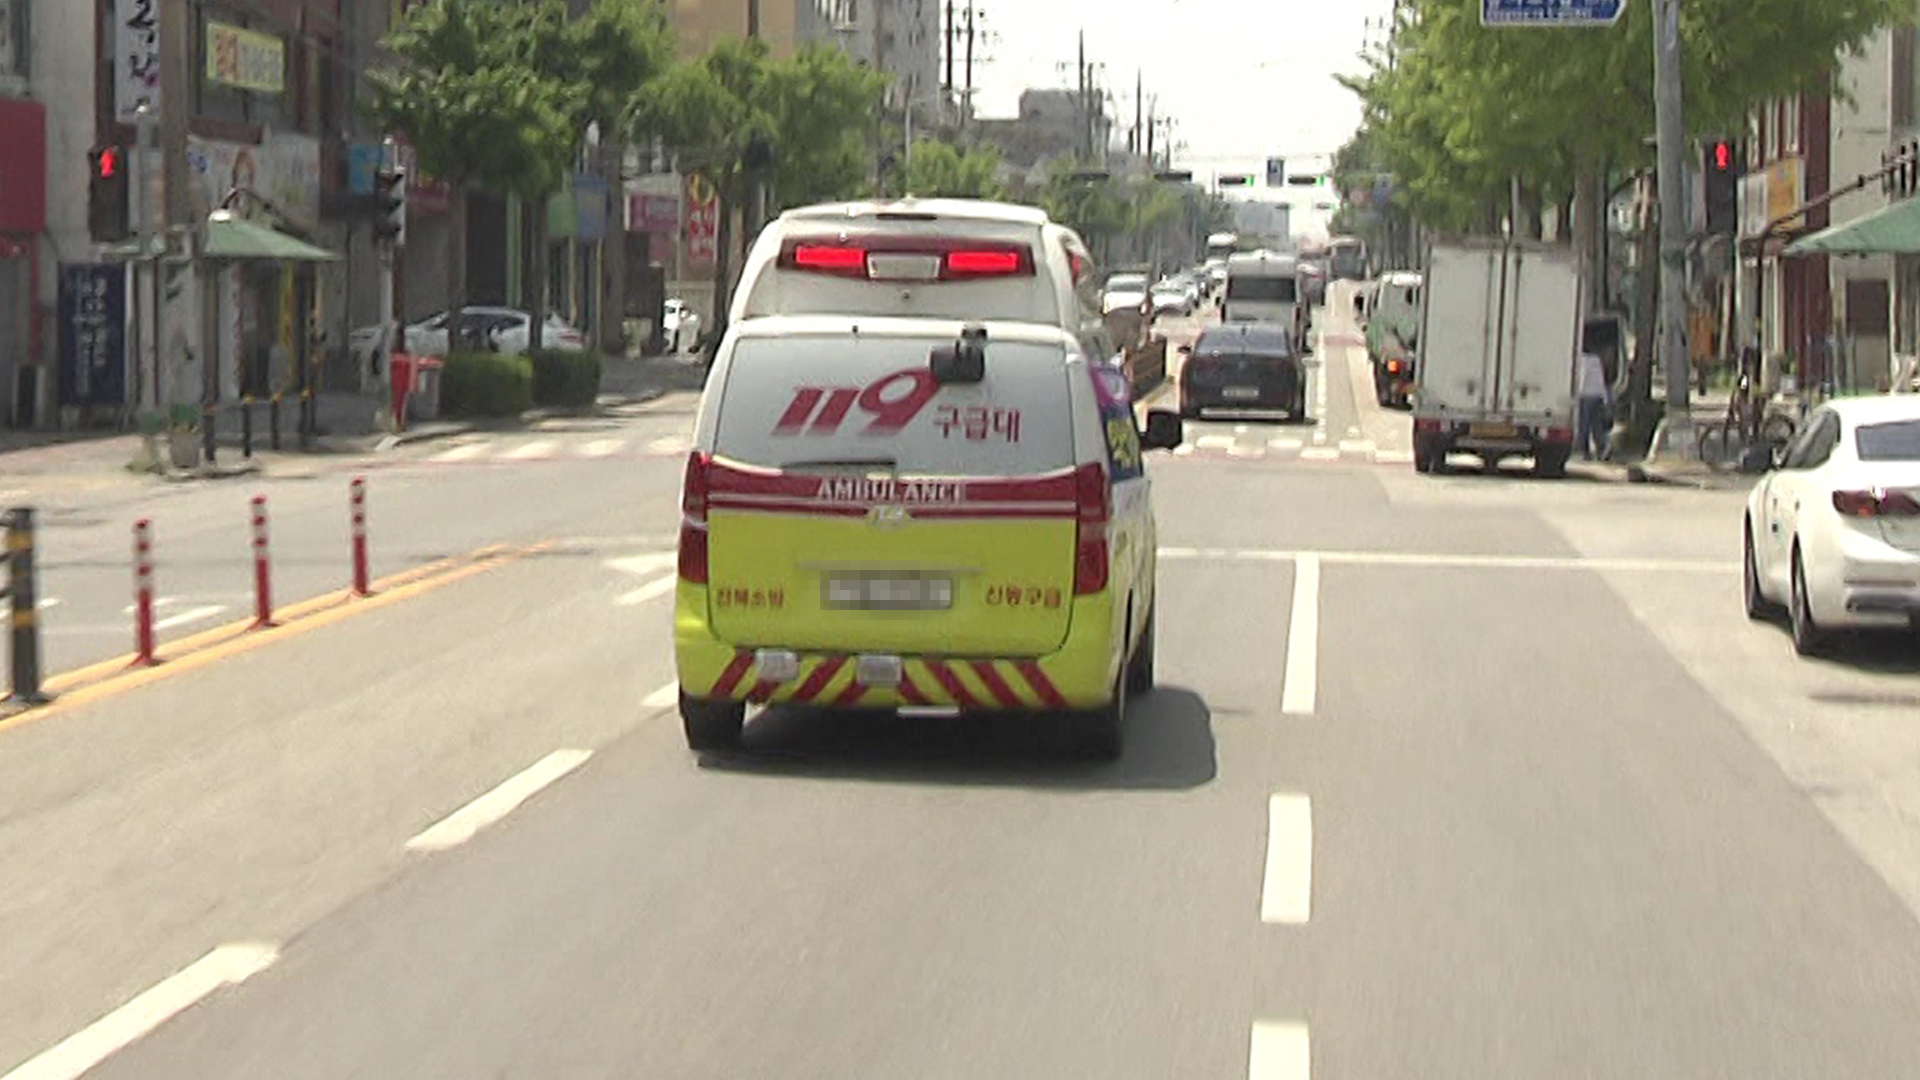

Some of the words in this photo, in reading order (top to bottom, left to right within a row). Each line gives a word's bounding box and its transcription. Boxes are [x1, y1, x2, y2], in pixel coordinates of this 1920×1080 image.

[771, 368, 941, 436] 119
[934, 404, 1020, 443] 구급대
[818, 478, 966, 504] AMBULANCE
